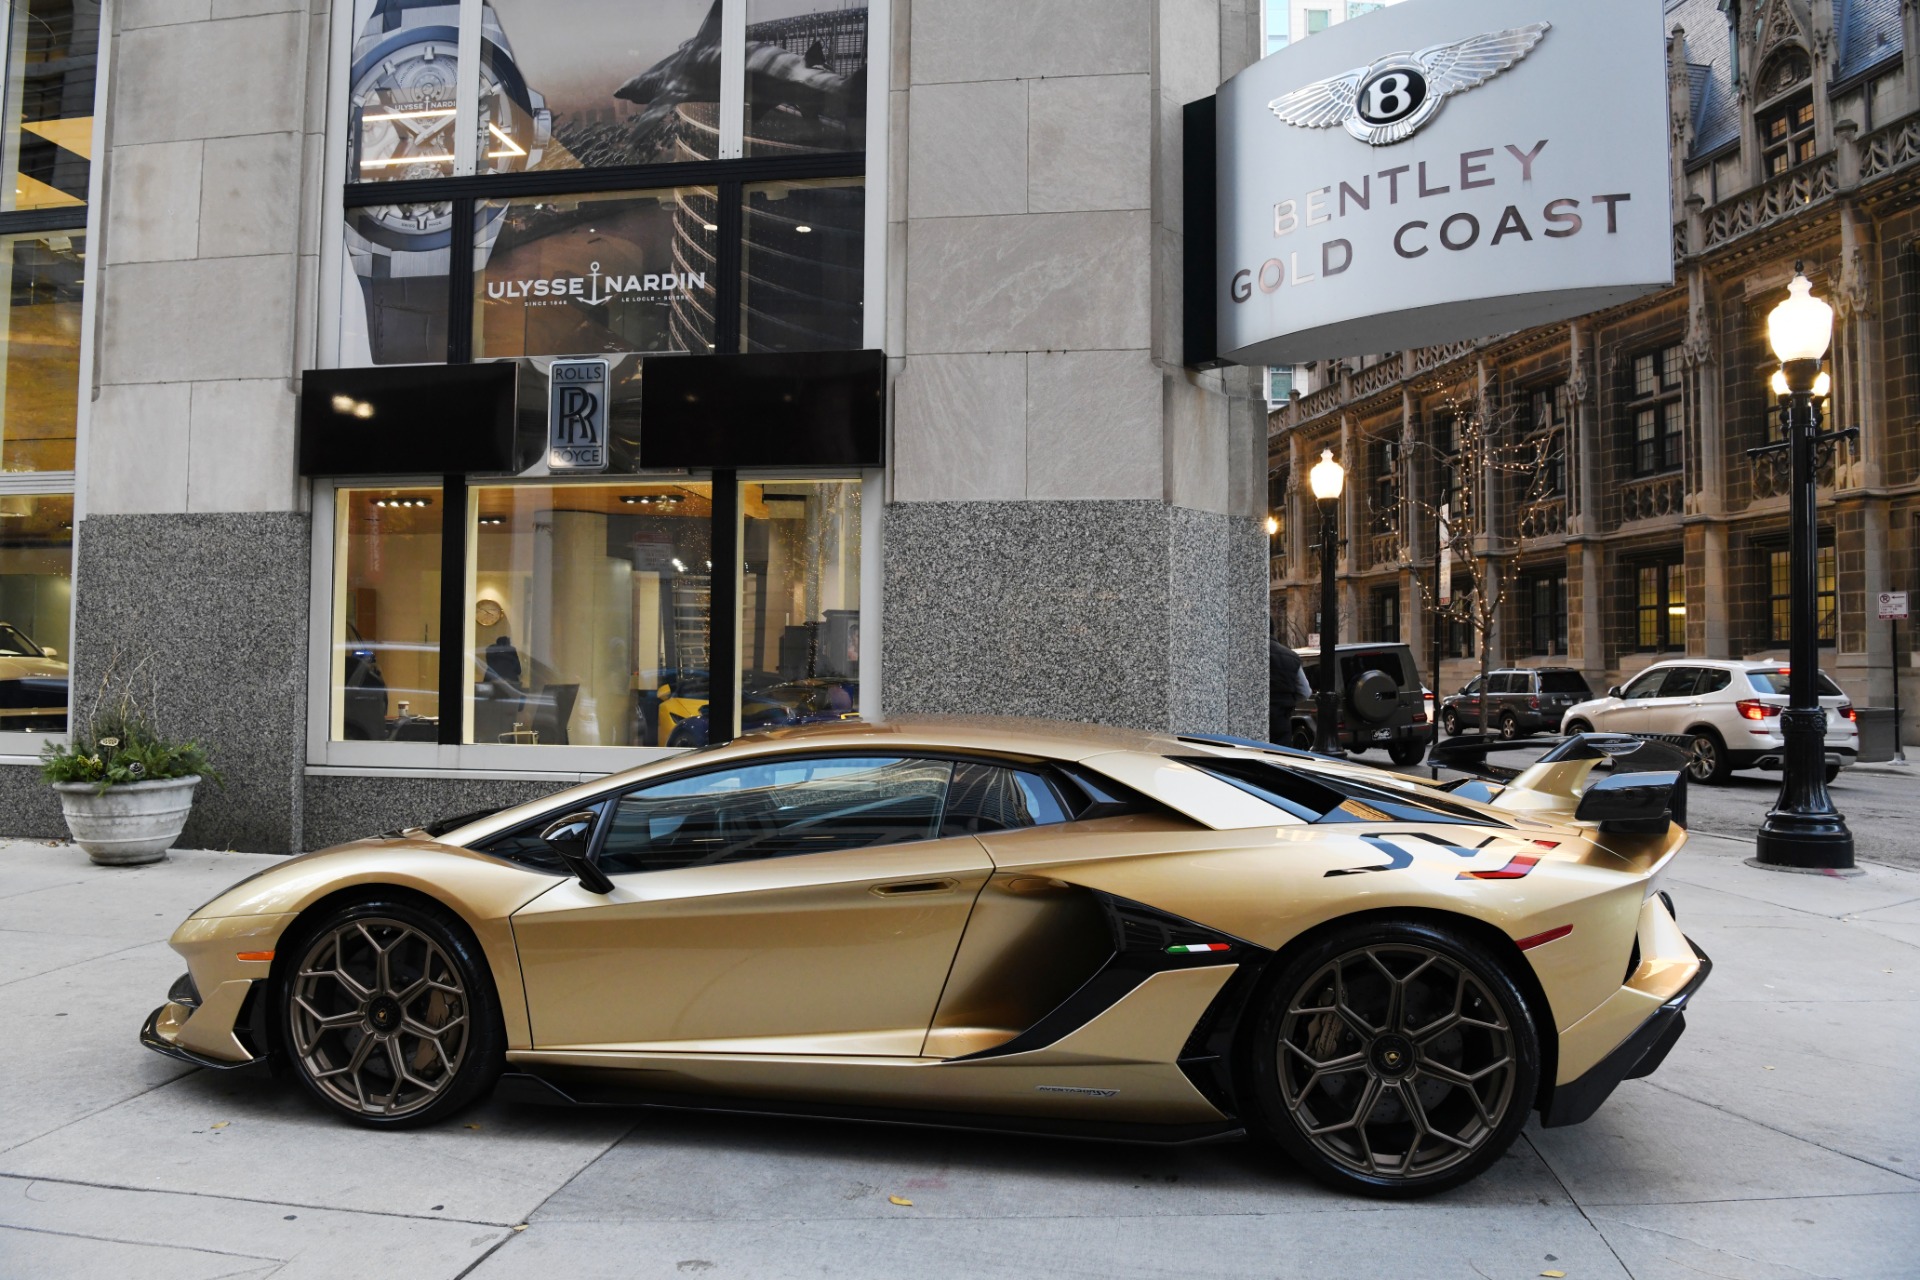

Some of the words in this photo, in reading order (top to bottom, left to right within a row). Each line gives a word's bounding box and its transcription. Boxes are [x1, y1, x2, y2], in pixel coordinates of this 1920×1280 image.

[1273, 139, 1549, 238] BENTLEY
[1230, 238, 1353, 304] GOLD
[1393, 193, 1631, 259] COAST
[488, 277, 584, 299] ULYSSE
[605, 272, 705, 293] NARDIN
[555, 367, 602, 380] ROLLS
[553, 449, 600, 463] ROYCE
[1323, 831, 1562, 881] SVJ
